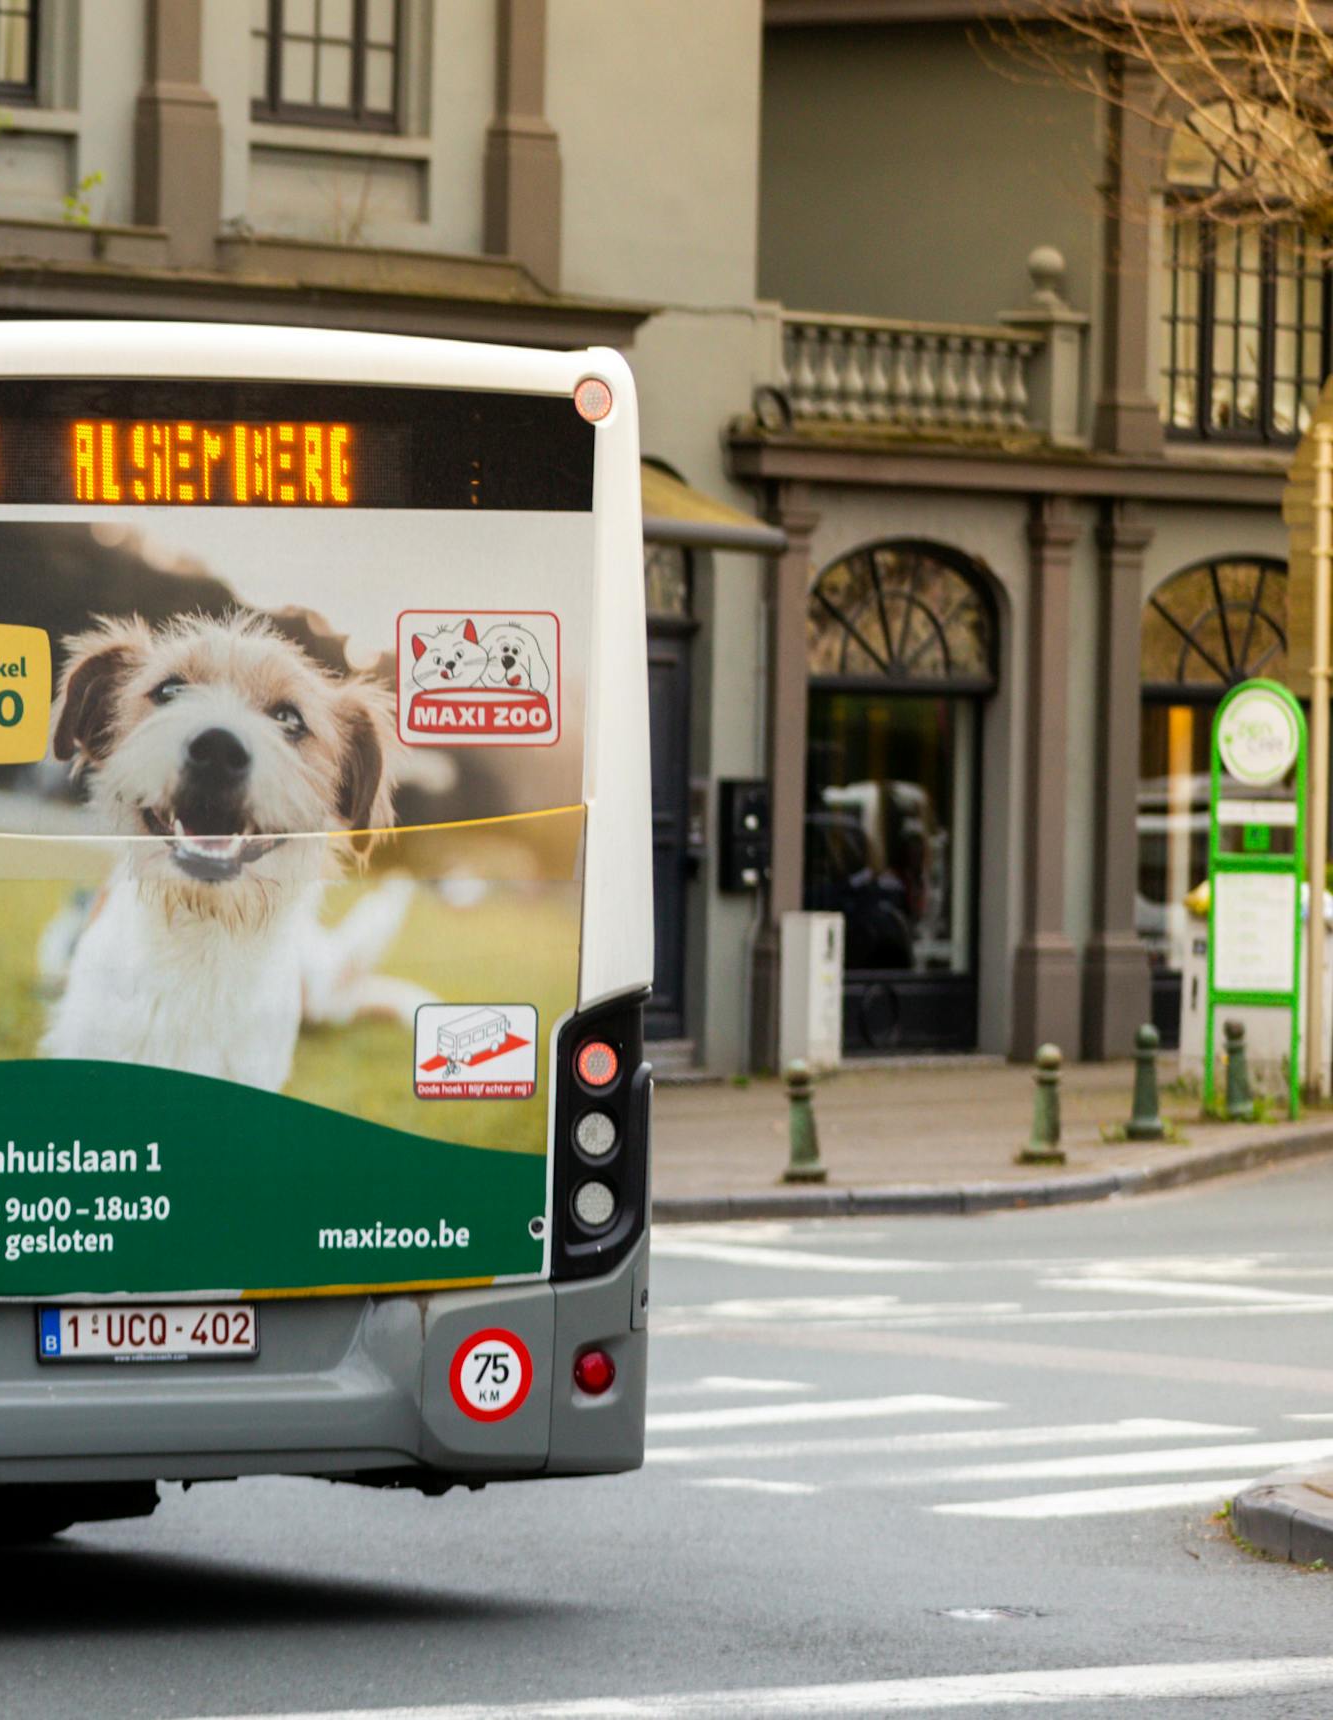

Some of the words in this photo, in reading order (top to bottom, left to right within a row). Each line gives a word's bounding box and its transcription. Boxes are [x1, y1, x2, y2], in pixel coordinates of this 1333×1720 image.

[414, 706, 485, 727] MAXI
[493, 706, 547, 727] ZOO
[418, 1083, 440, 1094] Dode
[485, 1083, 512, 1094] achter
[146, 1142, 162, 1172] 1
[5, 1197, 71, 1222] 9u00
[94, 1195, 170, 1221] 18u30
[5, 1226, 113, 1261] gesloten
[319, 1219, 470, 1248] maxizoo.be
[45, 1335, 58, 1351] B
[473, 1352, 510, 1385] 75
[479, 1389, 501, 1402] KM
